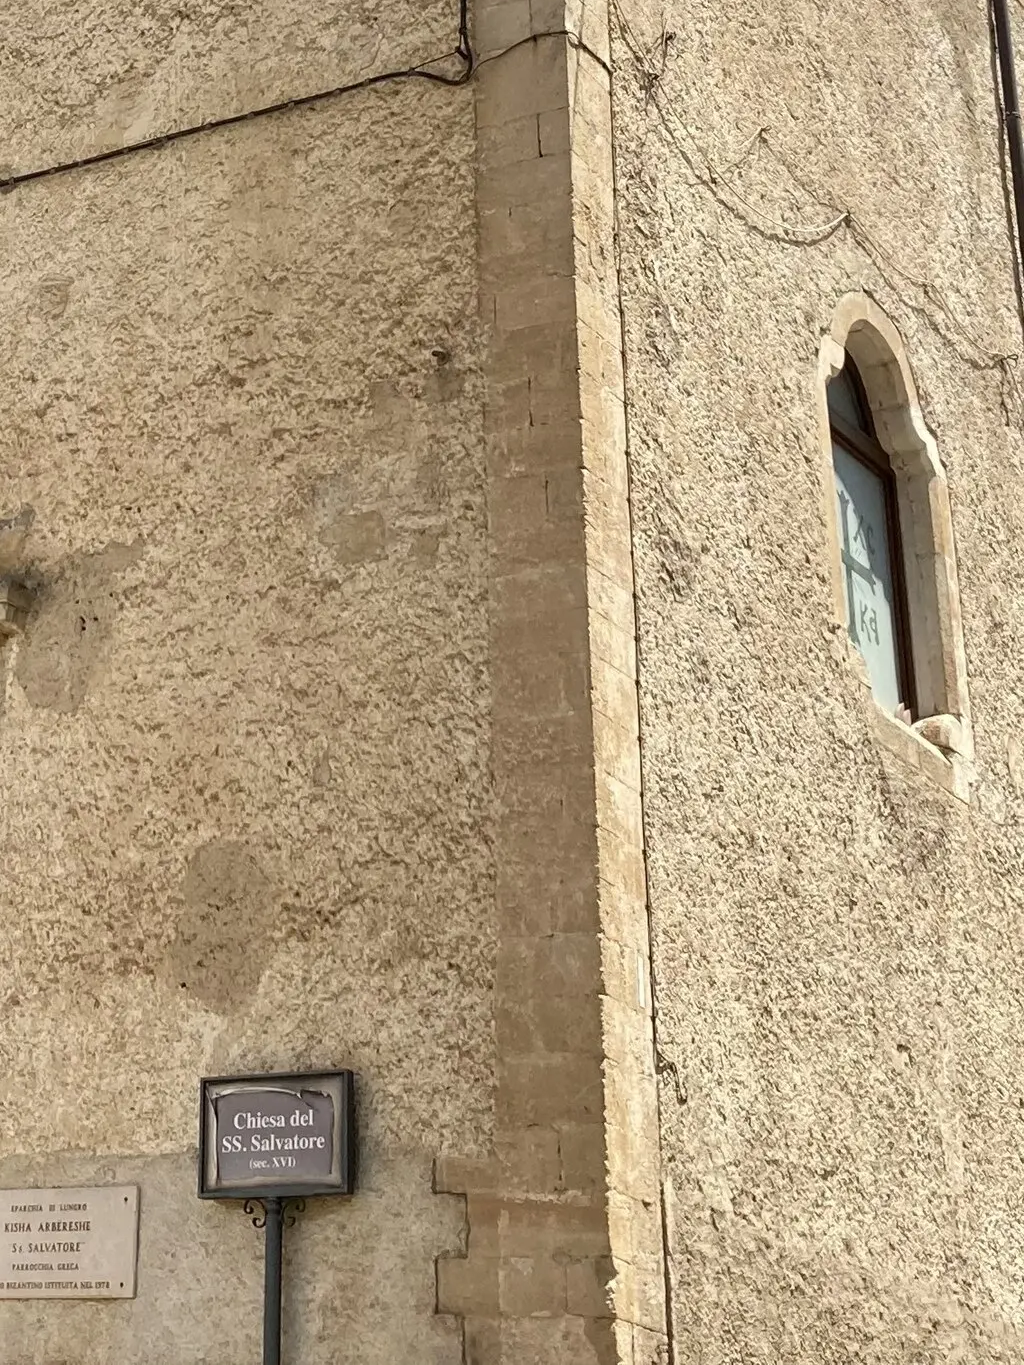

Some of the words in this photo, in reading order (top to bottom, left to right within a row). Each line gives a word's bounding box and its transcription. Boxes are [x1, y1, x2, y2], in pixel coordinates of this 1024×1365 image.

[233, 1112, 285, 1129] Chiesa
[290, 1109, 313, 1126] del
[221, 1135, 247, 1153] SS.
[251, 1134, 325, 1152] Salvatore
[249, 1157, 270, 1170] (sec.
[272, 1156, 296, 1168] XVI)
[4, 1222, 32, 1233] KISHA
